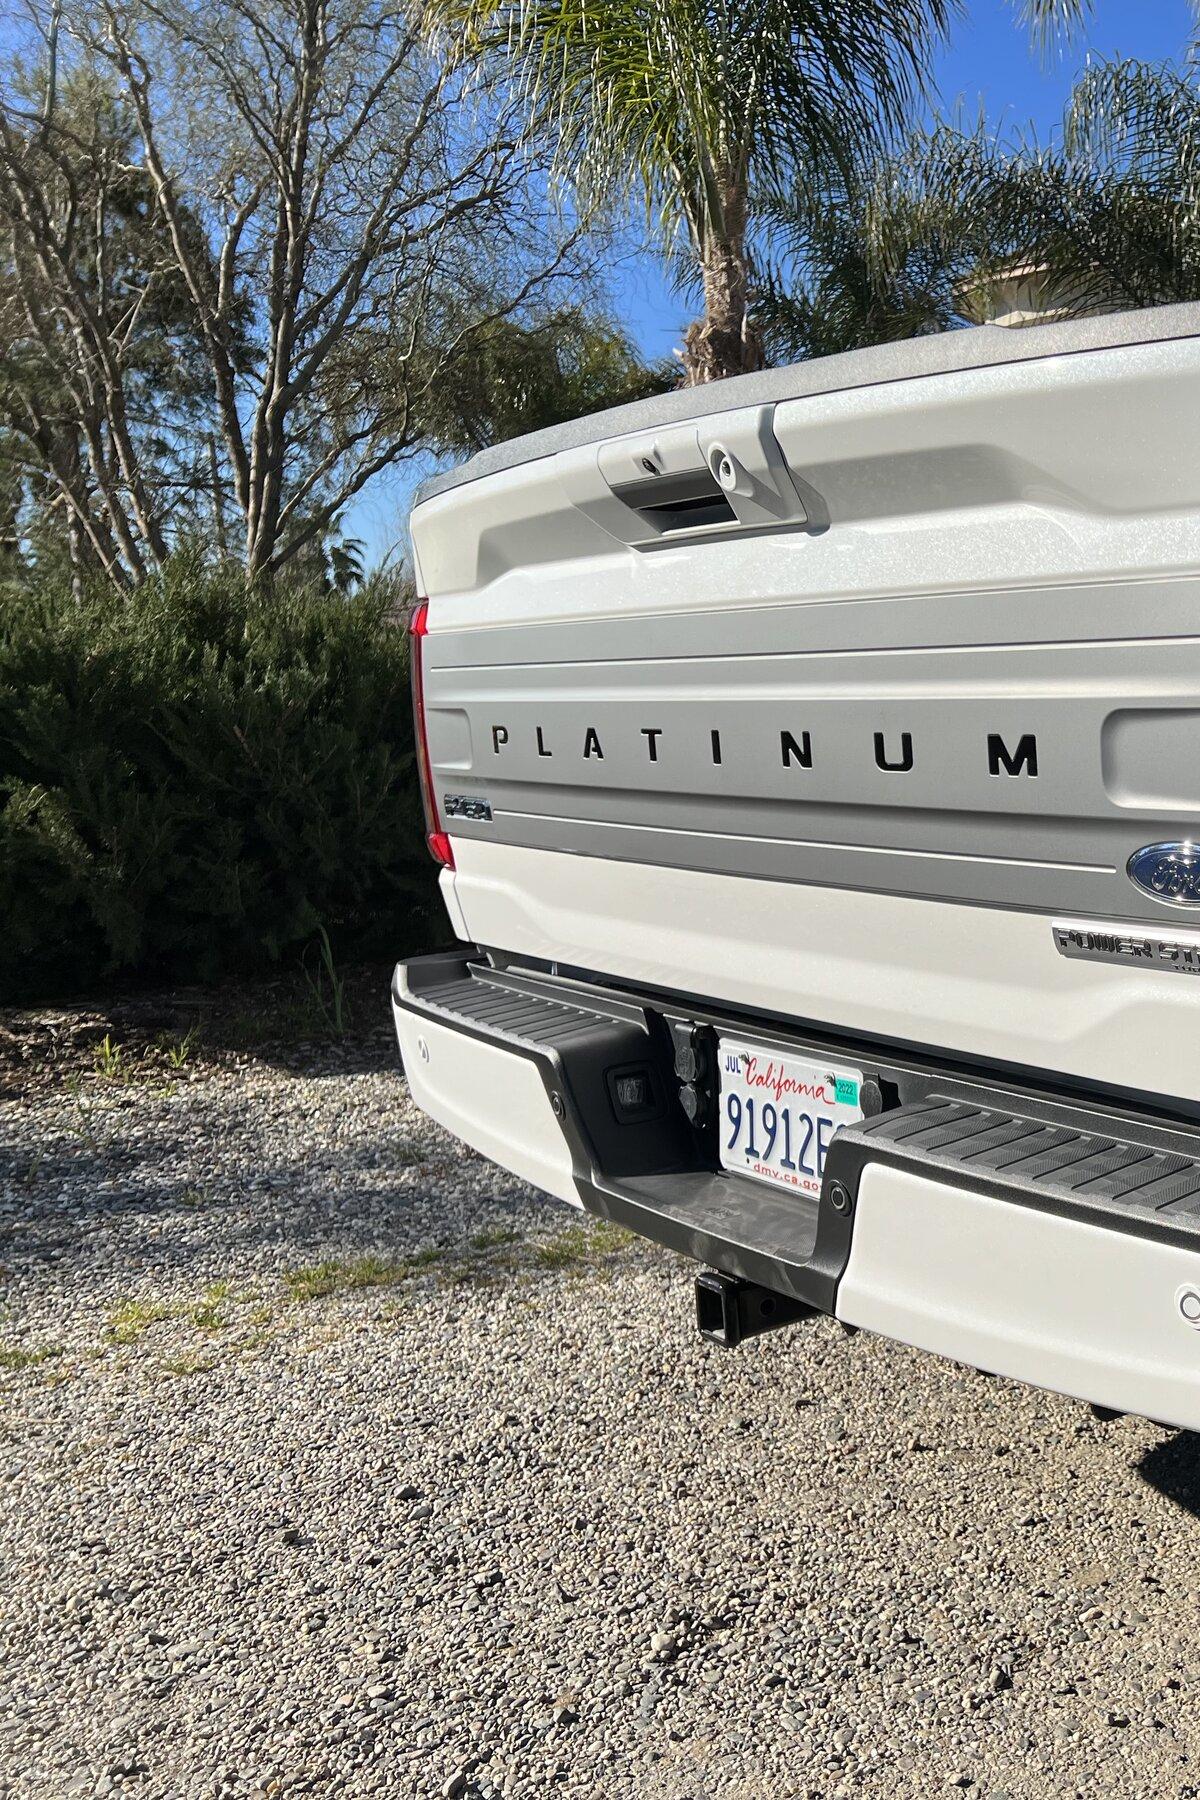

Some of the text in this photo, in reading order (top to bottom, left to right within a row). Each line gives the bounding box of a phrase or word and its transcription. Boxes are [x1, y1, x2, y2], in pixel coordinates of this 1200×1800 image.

[491, 725, 1039, 778] PLATINUM
[1057, 928, 1153, 958] POWER
[725, 1055, 742, 1075] JUL
[743, 1057, 836, 1105] California
[838, 1081, 854, 1094] 2022
[727, 1093, 847, 1179] 91912E
[753, 1163, 823, 1192] dmv.ca.go
